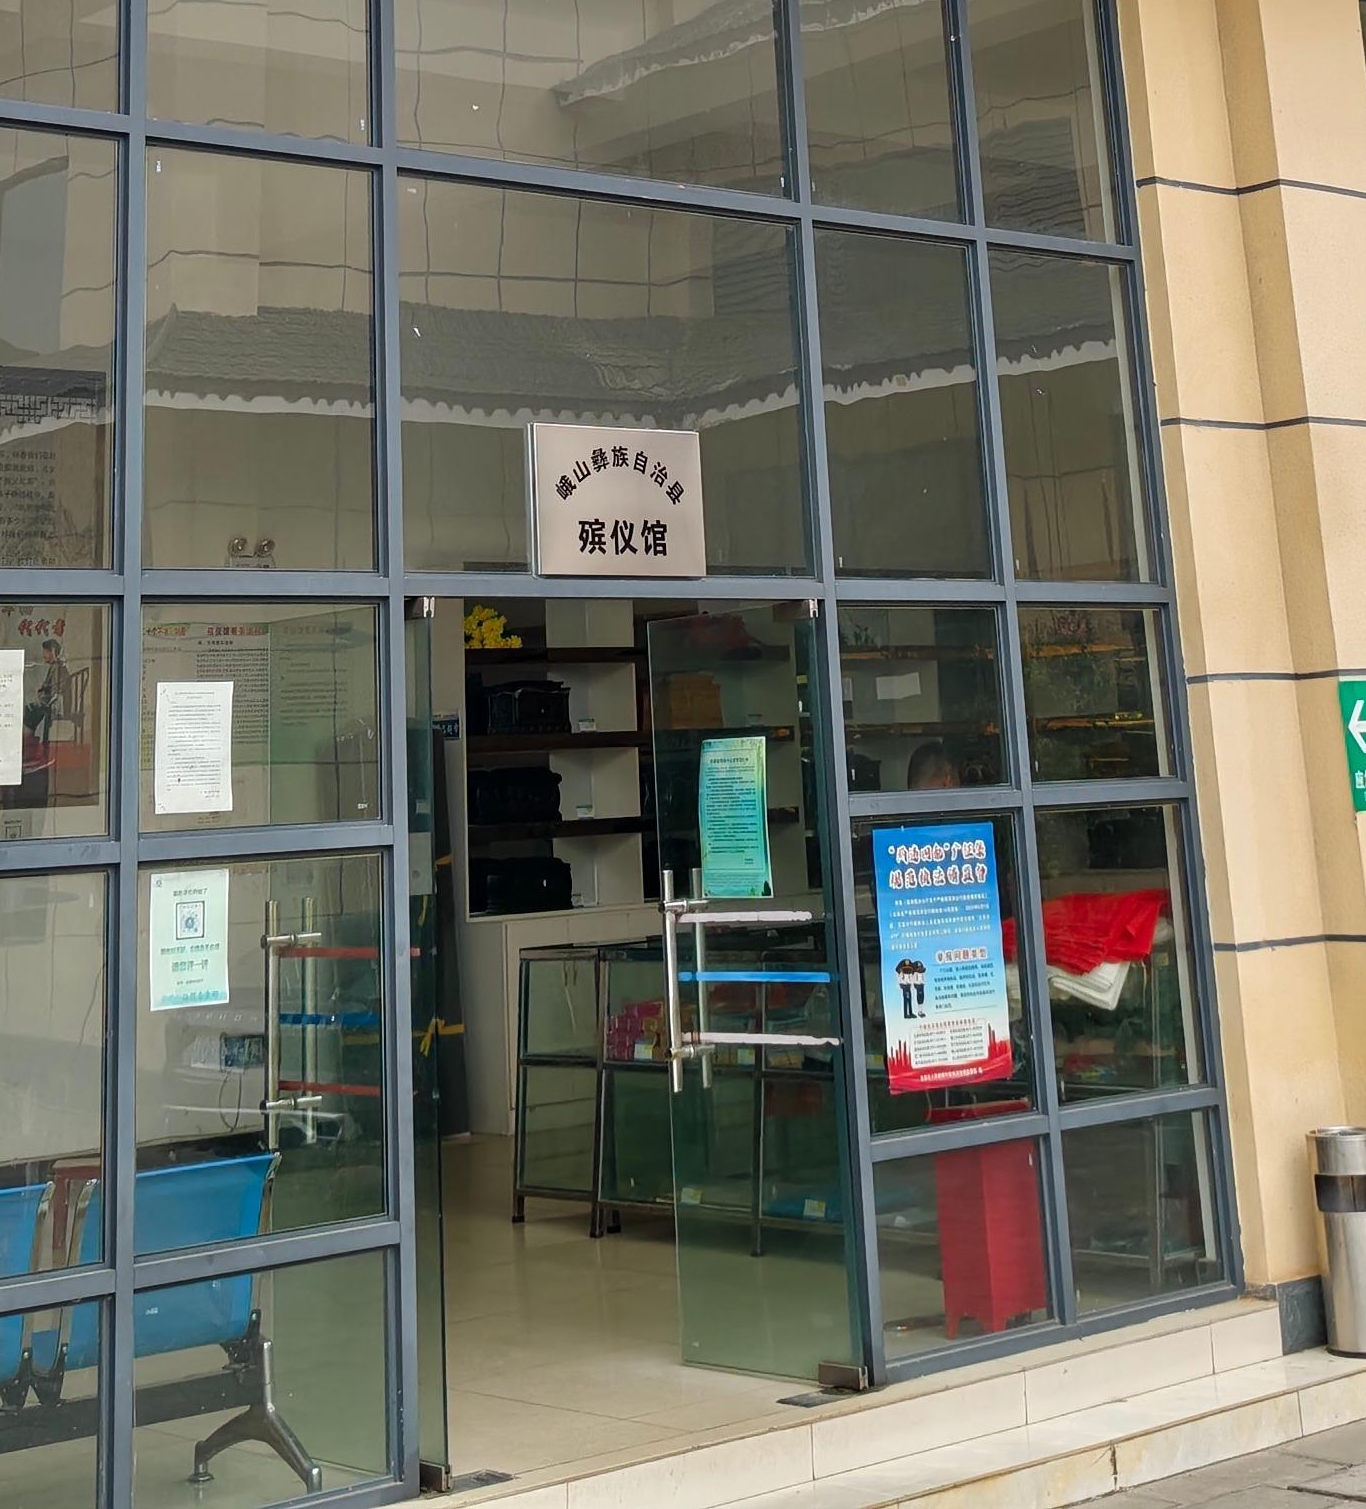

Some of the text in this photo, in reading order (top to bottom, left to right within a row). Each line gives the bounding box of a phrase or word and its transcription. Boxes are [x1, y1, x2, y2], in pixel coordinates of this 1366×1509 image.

[555, 445, 685, 504] 峨山彝族自治县
[578, 518, 668, 556] 殡仪馆
